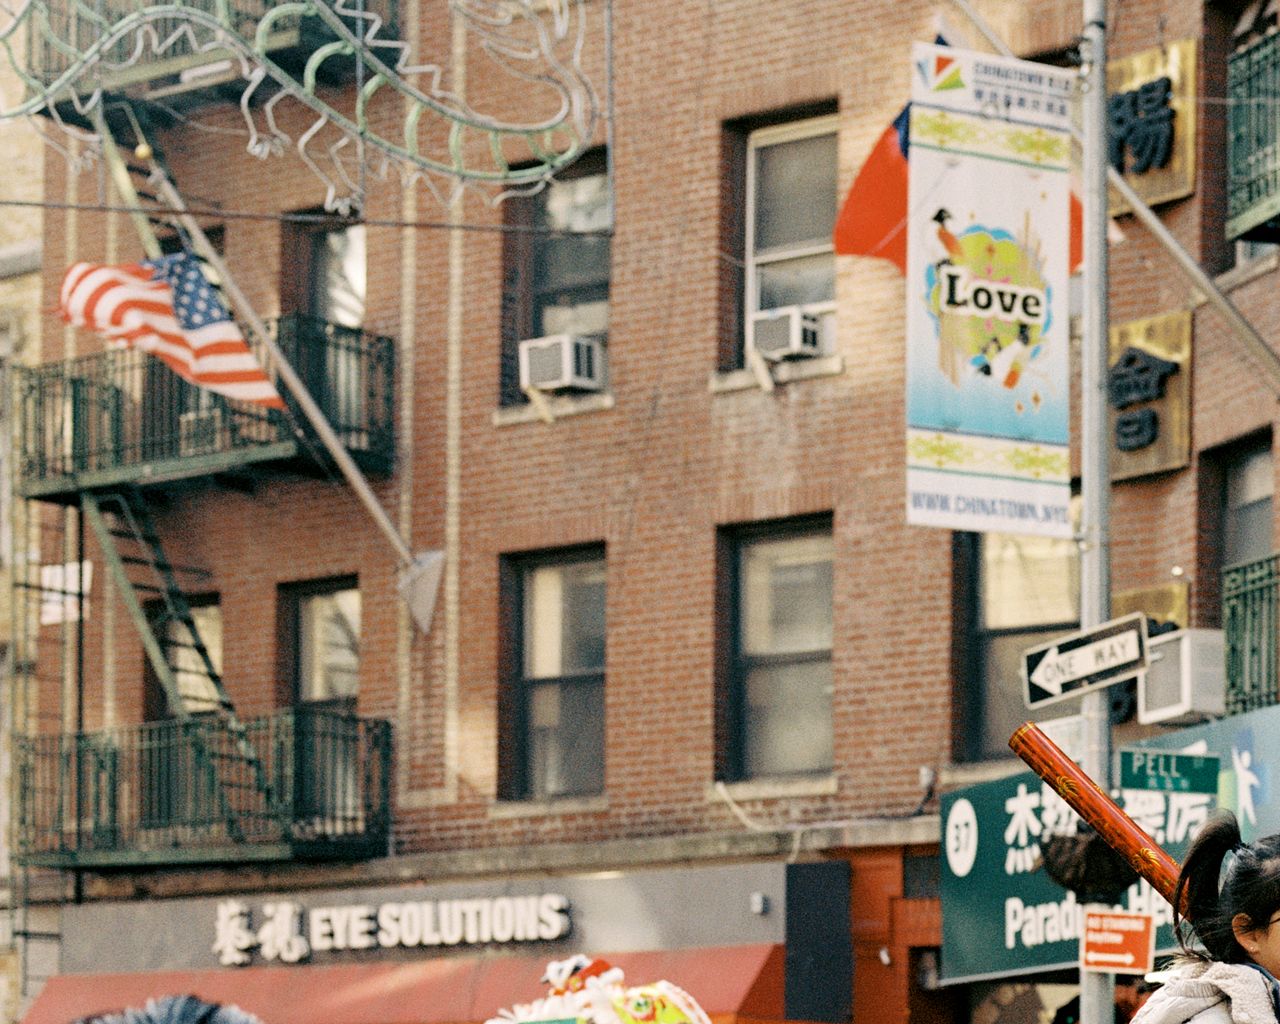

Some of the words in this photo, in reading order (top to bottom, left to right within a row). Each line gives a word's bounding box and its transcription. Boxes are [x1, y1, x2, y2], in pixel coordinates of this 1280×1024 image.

[946, 273, 1041, 317] Love
[1043, 655, 1077, 682] ONE
[1093, 638, 1131, 667] WAY
[1132, 752, 1181, 777] PELL
[309, 905, 375, 950] EYE
[377, 893, 569, 947] SOLUTIONS
